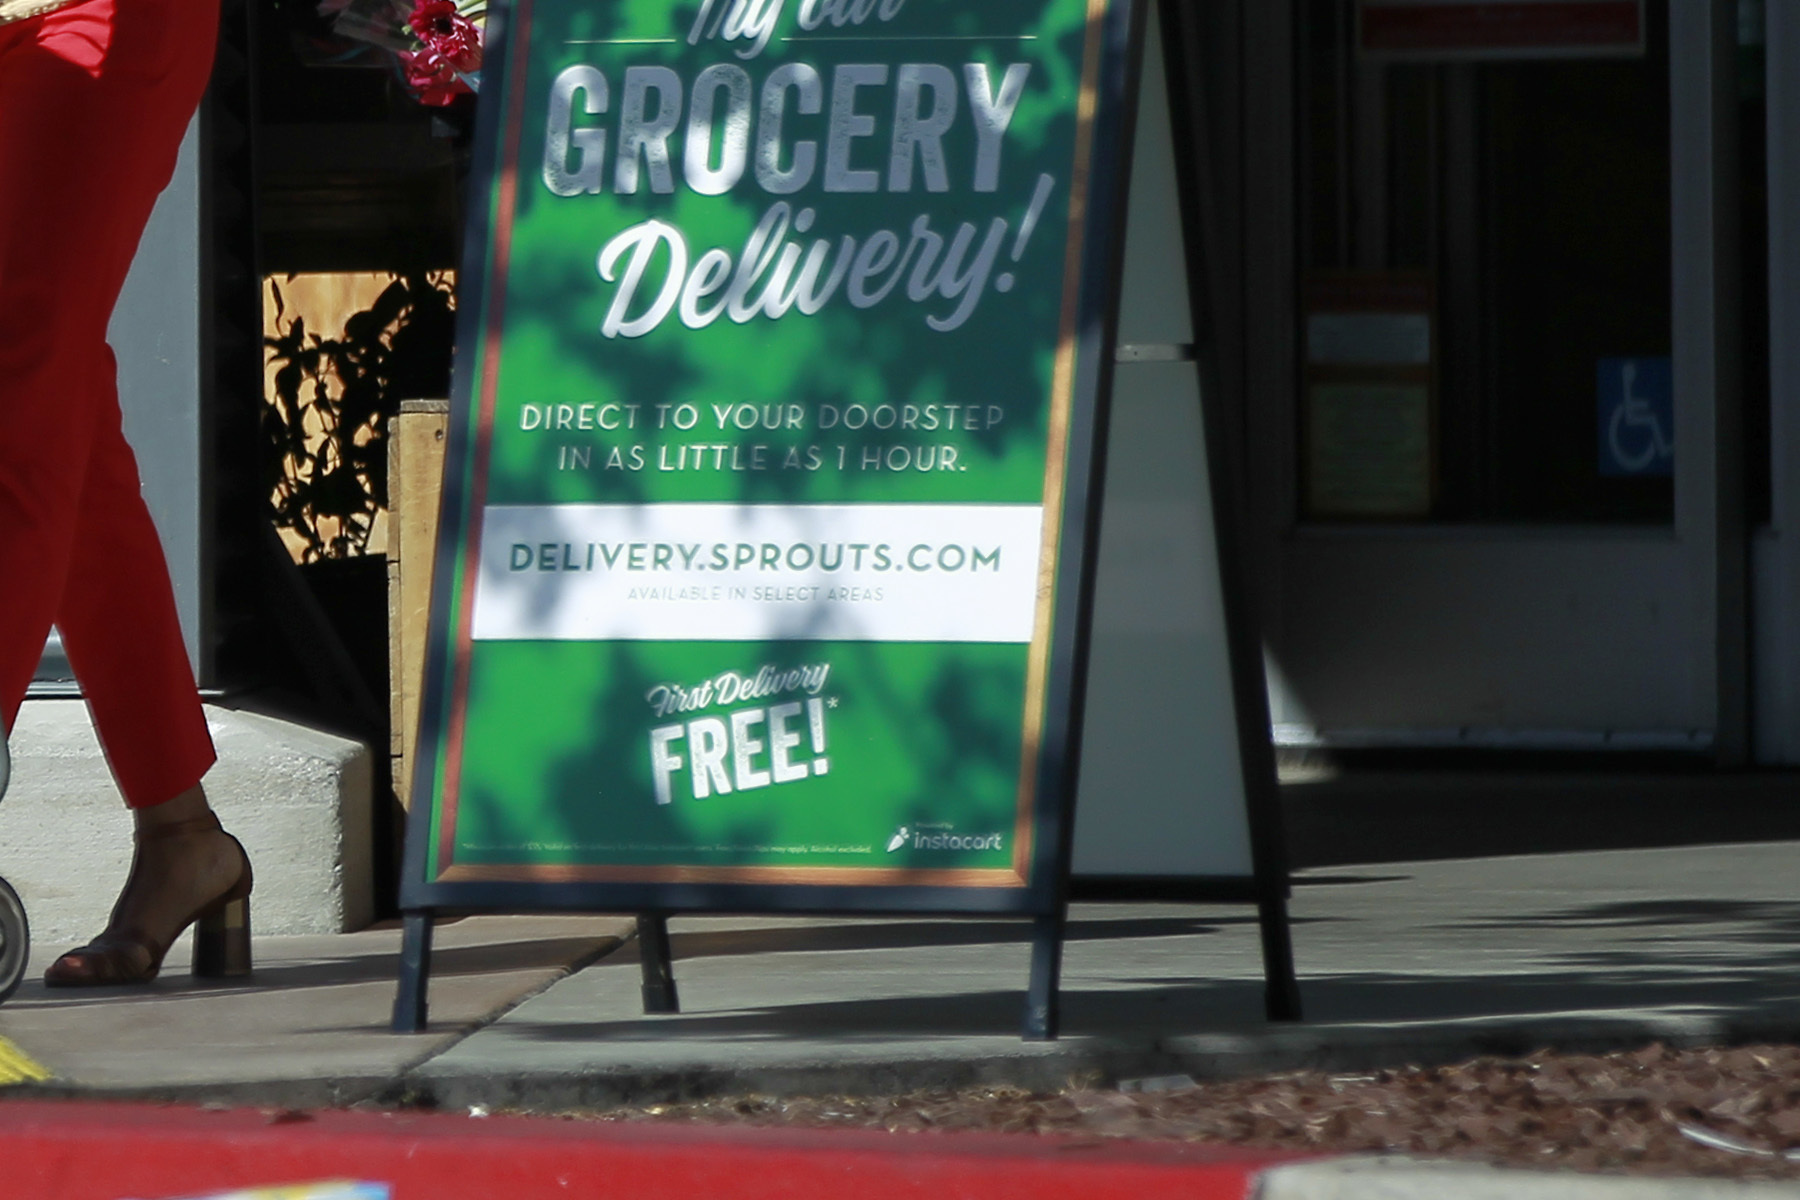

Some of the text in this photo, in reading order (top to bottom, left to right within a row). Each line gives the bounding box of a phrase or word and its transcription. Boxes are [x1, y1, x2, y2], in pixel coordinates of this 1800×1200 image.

[541, 61, 1032, 198] GROCERY
[596, 172, 1056, 340] Delivery!
[519, 403, 1005, 432] DIRECT TO YOUR DOORSTEP
[557, 445, 969, 472] IN AS LITTLE AS 1 HOUR.
[509, 542, 1002, 575] DELIVERY.SPROUTS.COM
[627, 585, 885, 602] AVAILABLE IN SELECT AREAS
[647, 663, 830, 718] First Delivery
[913, 831, 1003, 851] instacart
